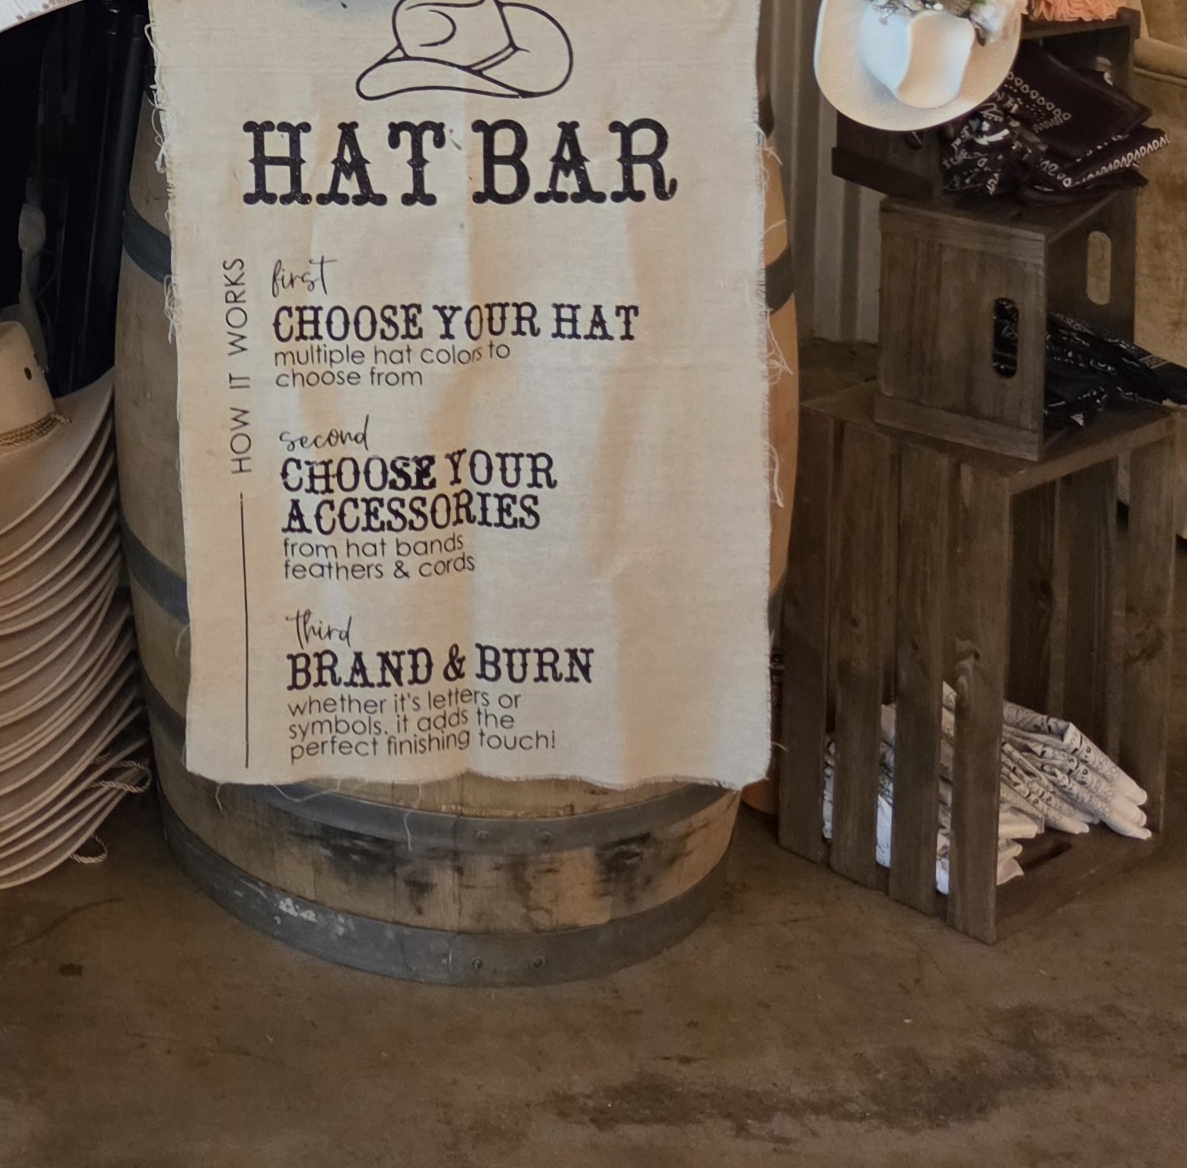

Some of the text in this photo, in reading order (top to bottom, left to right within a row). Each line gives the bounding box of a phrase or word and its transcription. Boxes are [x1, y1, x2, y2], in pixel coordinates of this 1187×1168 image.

[243, 118, 678, 206] HAT BAR
[272, 256, 336, 298] first
[272, 302, 639, 343] CHOOSE YOUR HAT
[222, 258, 251, 473] HOW IT WORKS
[275, 340, 510, 368] multiple hat colors to
[276, 364, 422, 387] choose from
[279, 414, 369, 451] second
[280, 448, 557, 495] CHOOSE YOUR
[281, 490, 541, 535] ACCESSORIES
[284, 534, 465, 559] from hat bands
[285, 553, 475, 580] feathers & cords
[286, 609, 352, 649] third
[286, 643, 594, 691] BRAND & BURN
[288, 688, 521, 716] whether it's letters or
[397, 714, 408, 733] it
[418, 706, 469, 731] adds
[477, 708, 514, 730] the
[290, 729, 555, 763] perfect finishing touch!
